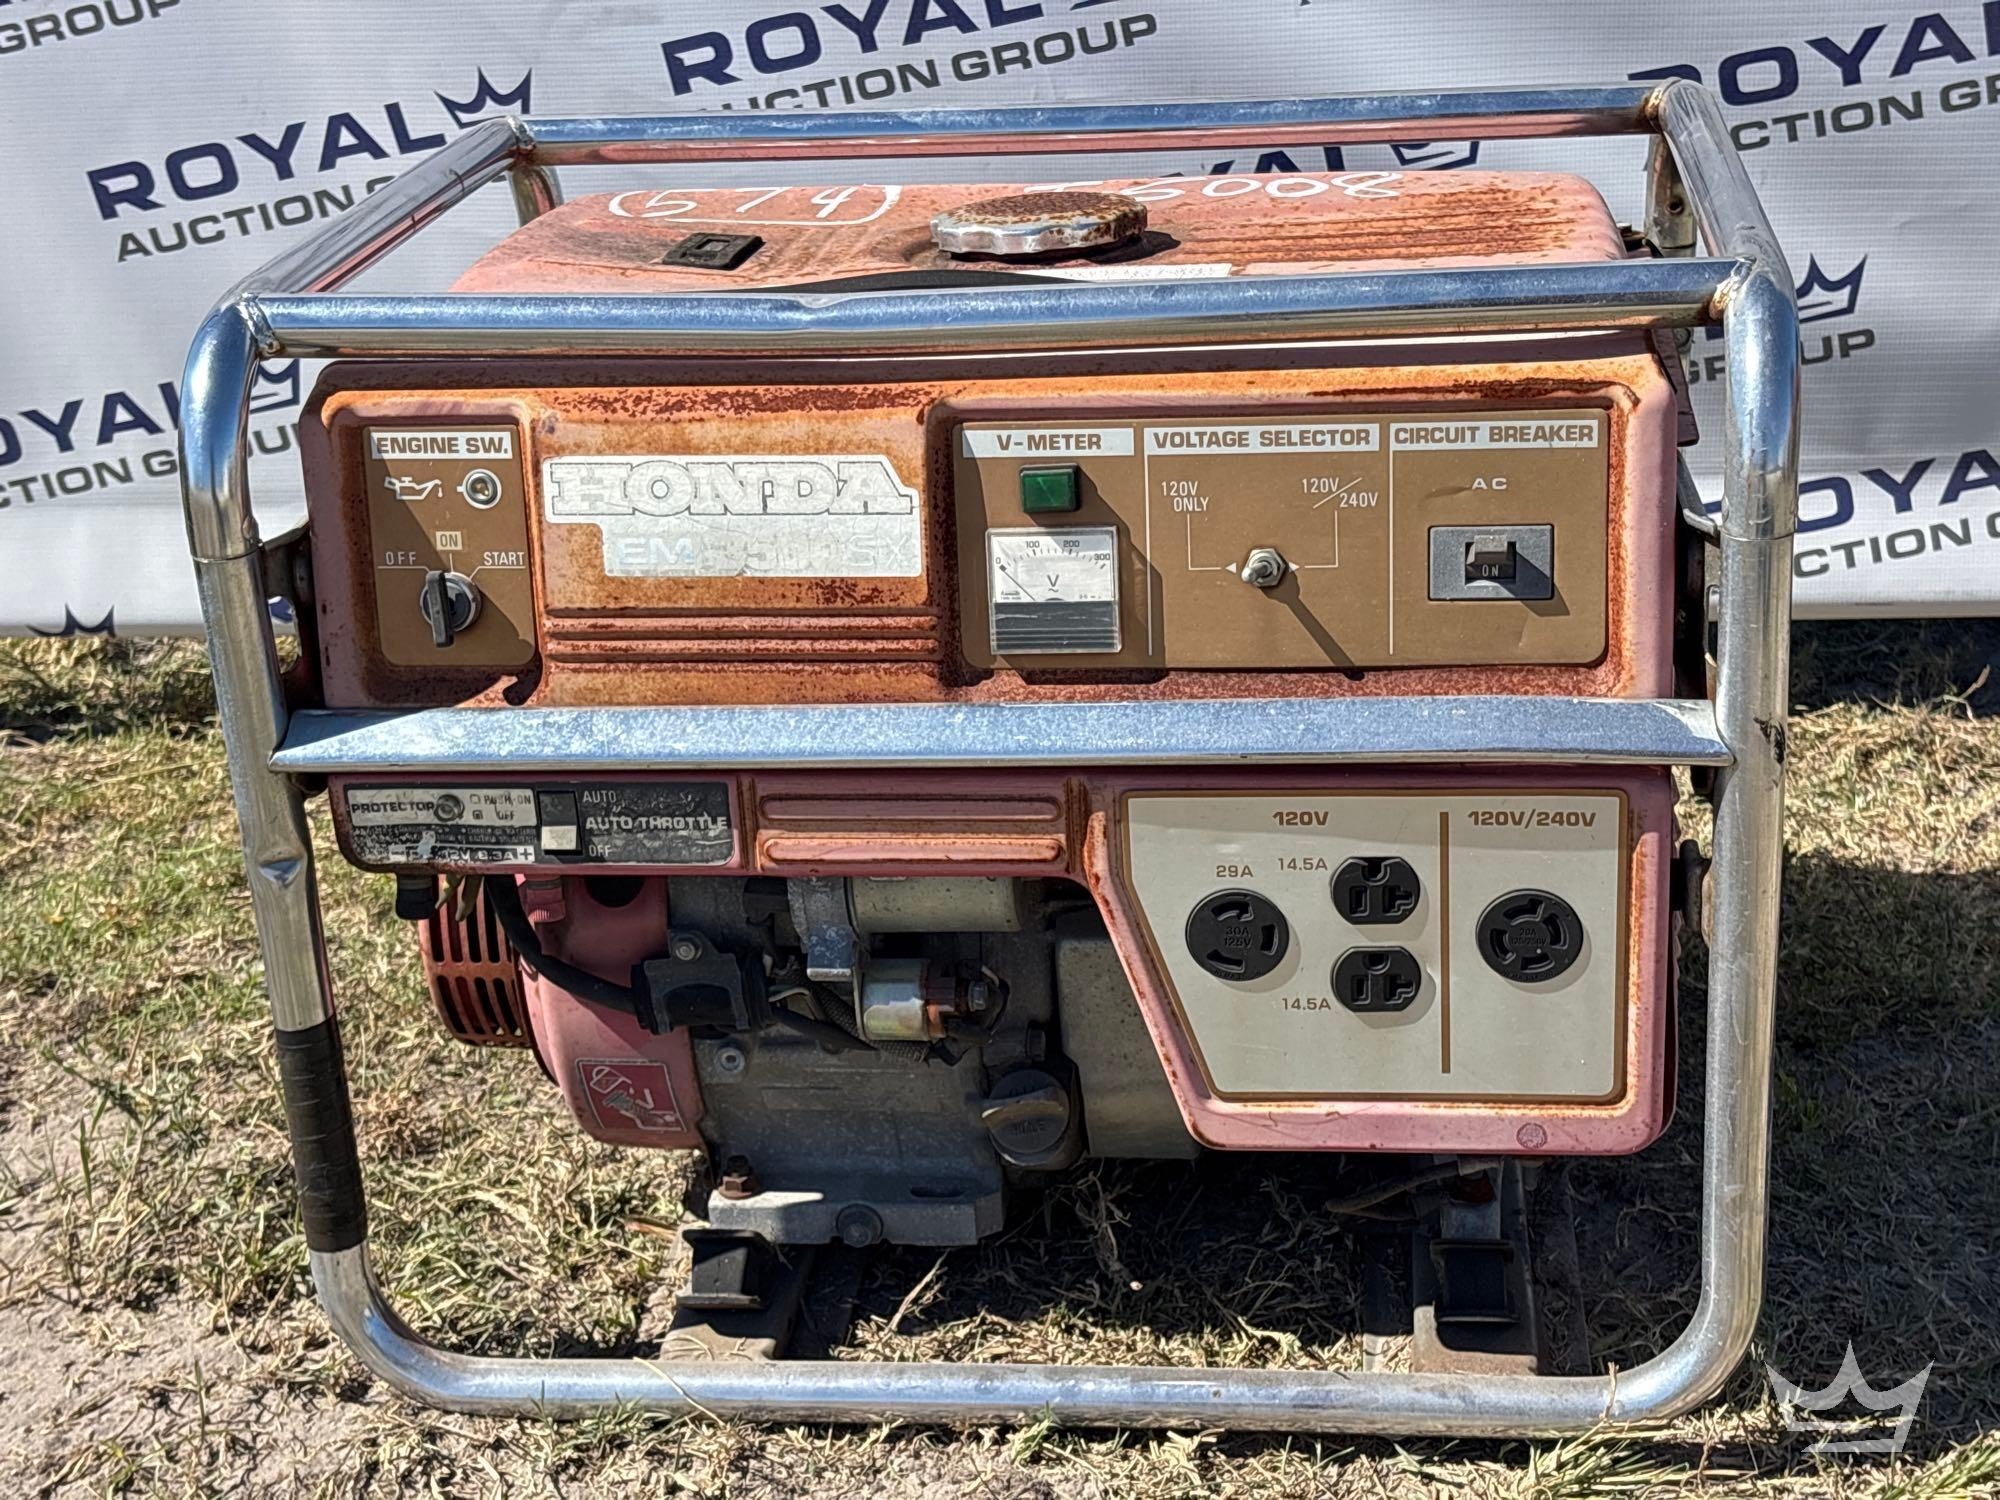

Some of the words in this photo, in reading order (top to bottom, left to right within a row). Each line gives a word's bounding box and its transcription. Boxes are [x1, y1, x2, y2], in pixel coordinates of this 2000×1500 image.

[953, 14, 1157, 82] GROUP
[87, 102, 446, 221] ROYAL
[117, 183, 356, 262] AUCTION
[996, 433, 1102, 451] V-METER
[1153, 431, 1250, 449] VOLTAGE
[1259, 428, 1371, 447] SELECTOR
[1394, 426, 1480, 445] CIRCUIT
[1489, 425, 1594, 443] BREAKER
[376, 437, 460, 454] ENGINE
[465, 437, 509, 454] SW.
[550, 460, 913, 517] HONDA
[1160, 481, 1198, 496] 120V
[1173, 497, 1209, 512] ONLY
[439, 533, 459, 548] ON
[1025, 540, 1040, 549] 100
[1063, 540, 1080, 548] 200
[385, 552, 417, 566] OFF
[483, 552, 525, 566] START
[1094, 553, 1110, 561] 300
[1482, 564, 1499, 577] ON
[1047, 574, 1059, 587] V
[583, 790, 617, 803] AUTO
[351, 801, 435, 814] PROTECTOR
[1272, 811, 1329, 826] 120V
[1468, 809, 1596, 829] 120V/240V
[589, 845, 612, 857] OFF
[1215, 864, 1254, 879] 29A
[1277, 857, 1328, 872] 14.5A
[1282, 997, 1331, 1011] 14.5A
